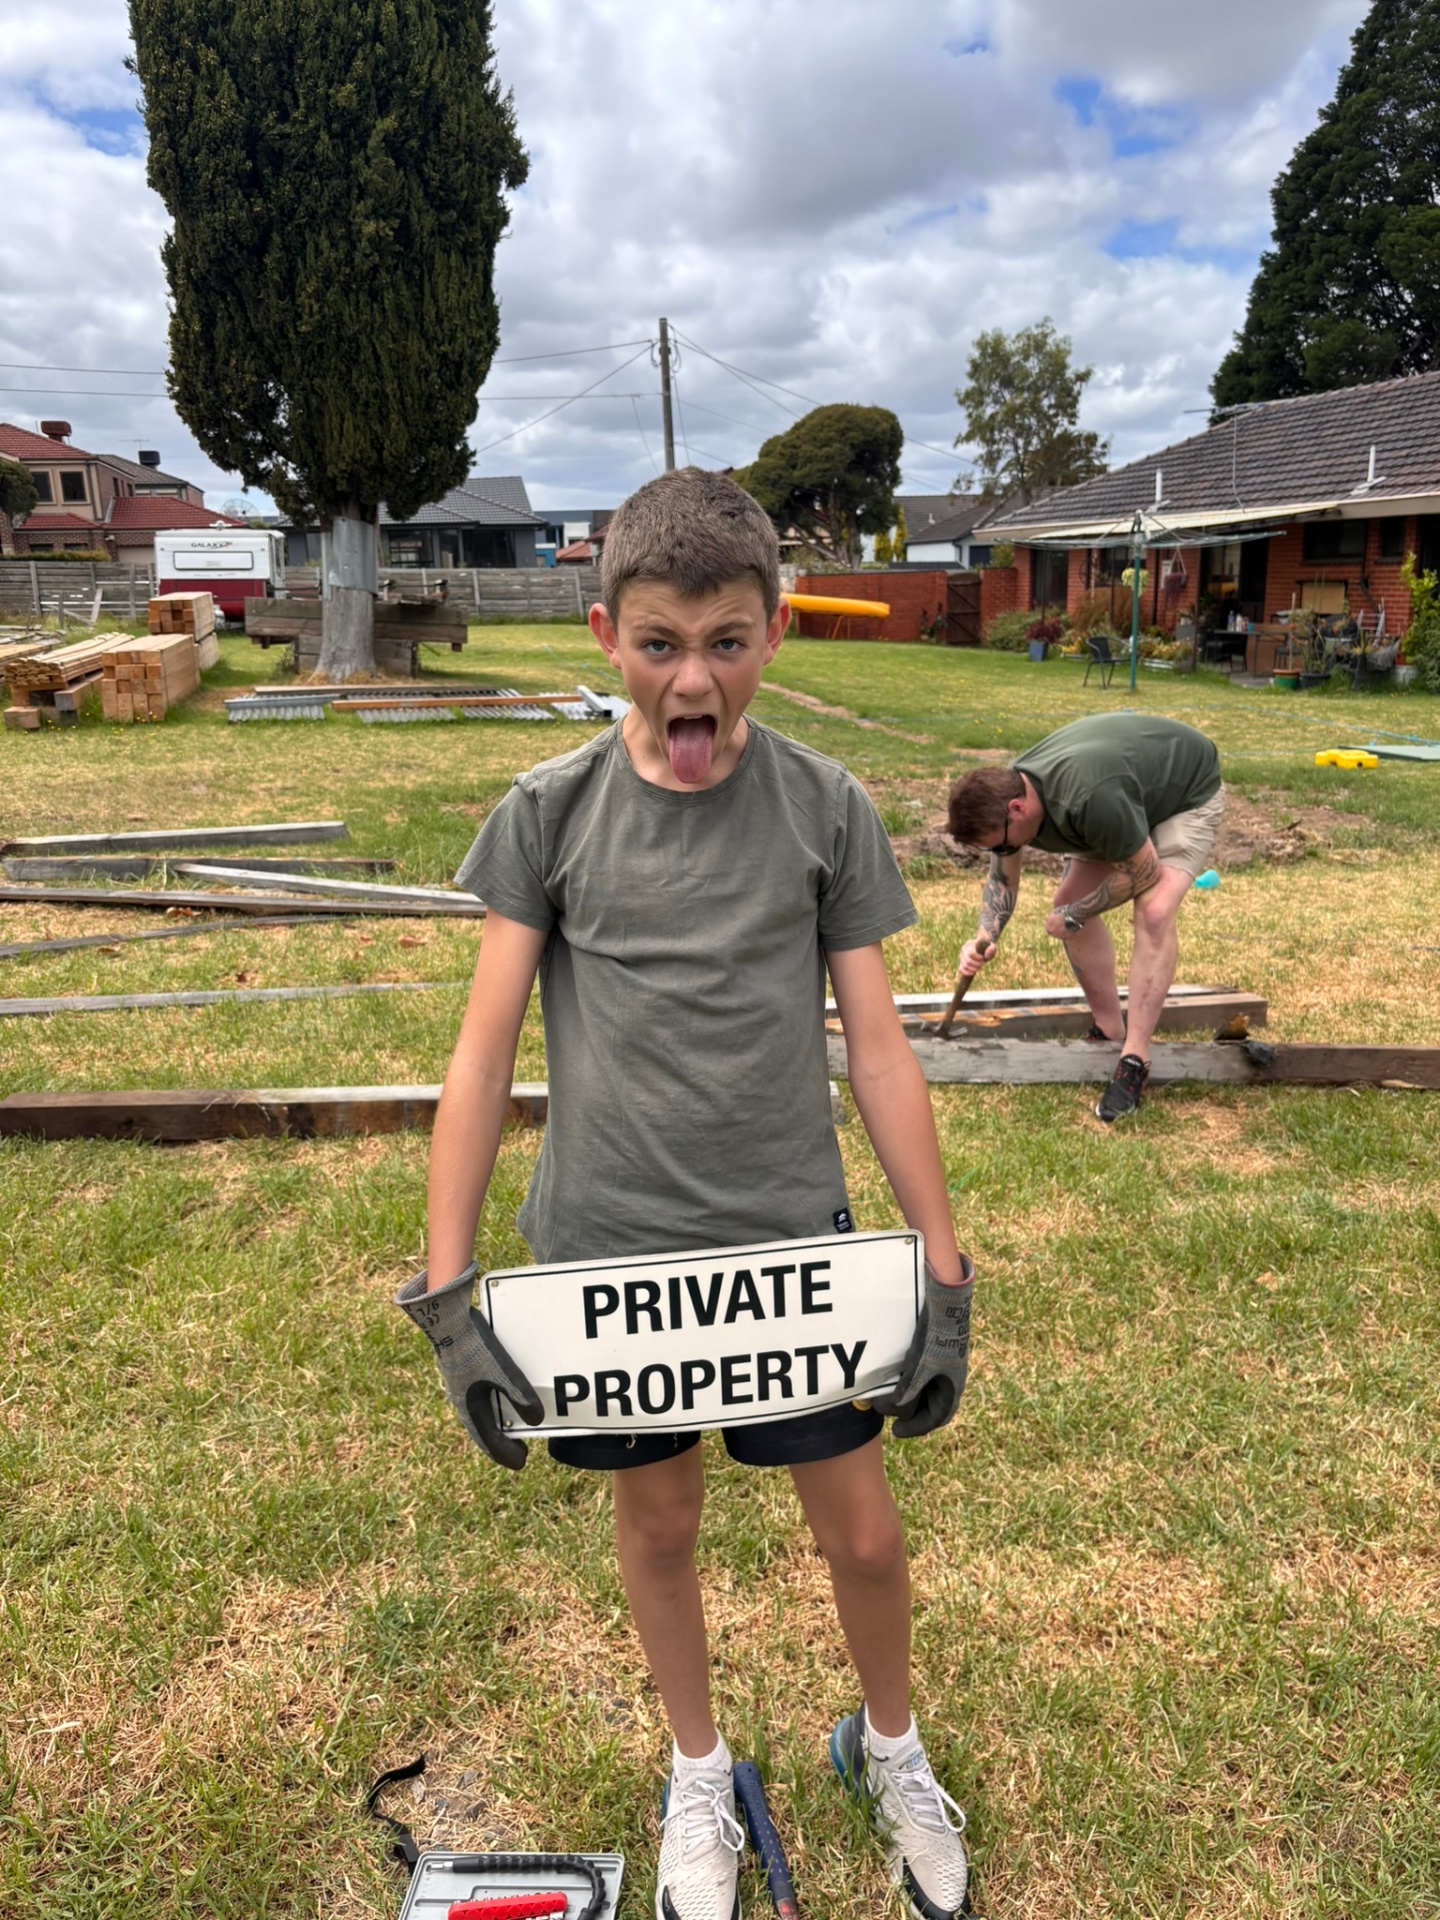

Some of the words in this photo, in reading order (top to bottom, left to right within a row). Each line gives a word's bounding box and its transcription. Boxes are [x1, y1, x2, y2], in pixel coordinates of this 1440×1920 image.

[191, 541, 225, 549] GALAXY
[583, 1261, 833, 1339] PRIVATE
[553, 1340, 868, 1417] PROPERTY
